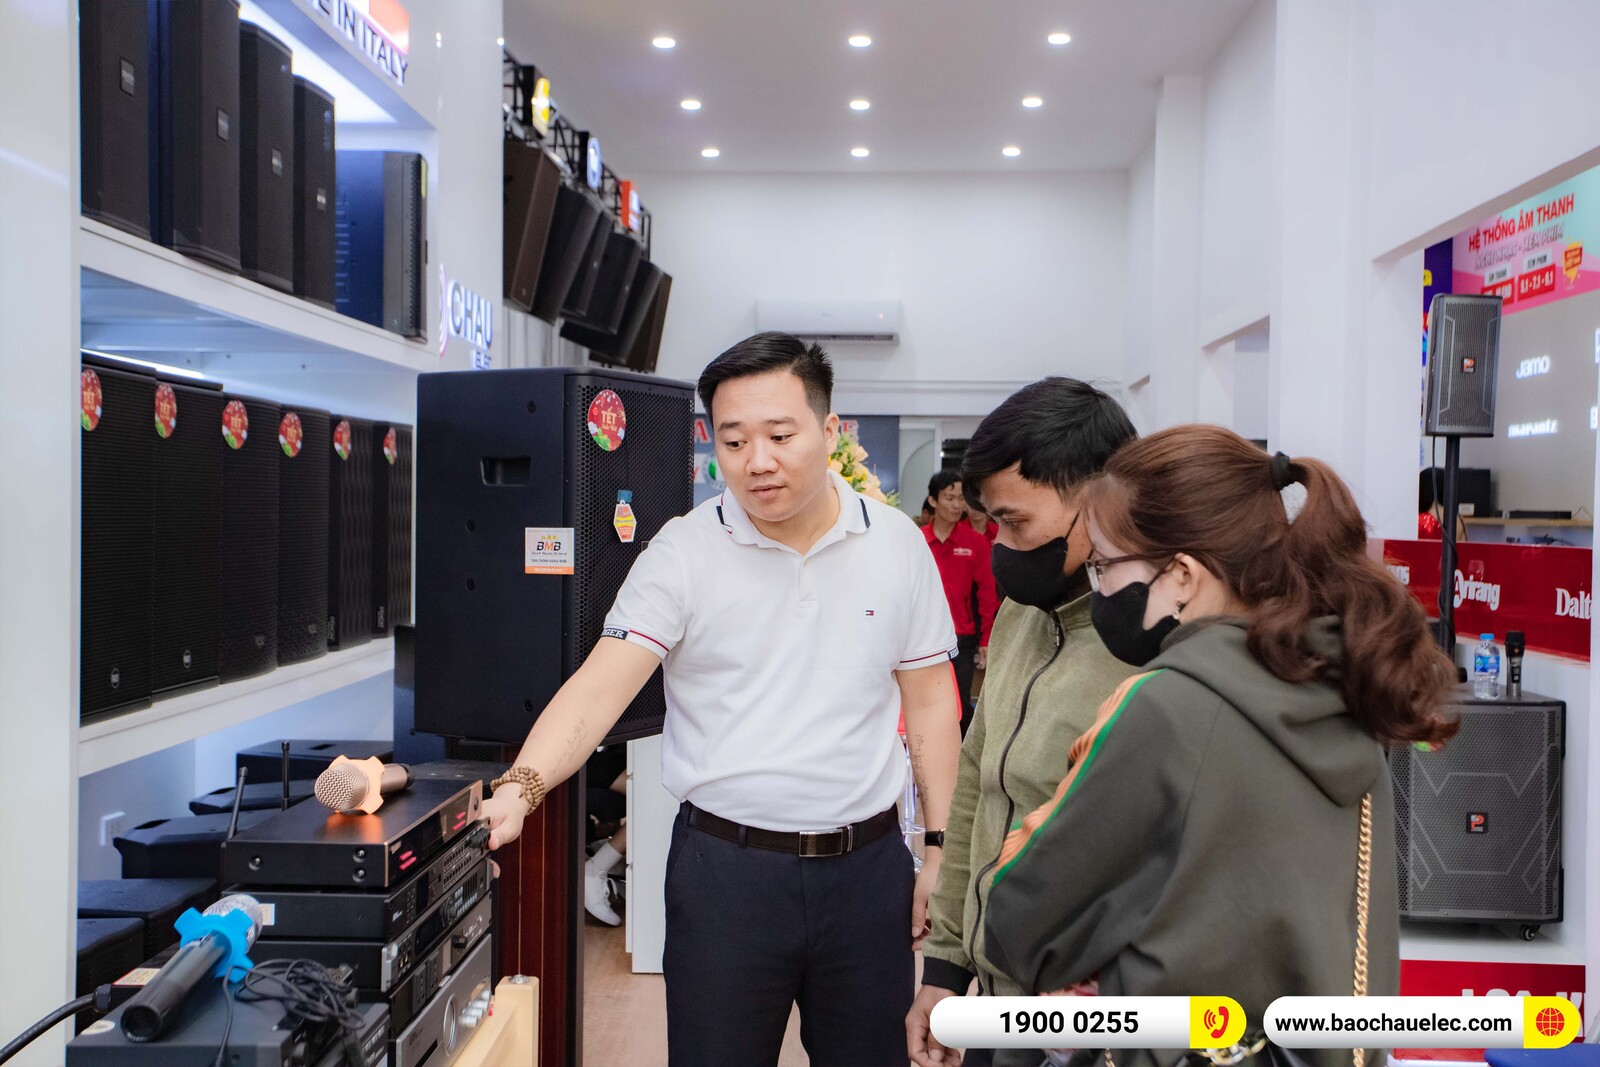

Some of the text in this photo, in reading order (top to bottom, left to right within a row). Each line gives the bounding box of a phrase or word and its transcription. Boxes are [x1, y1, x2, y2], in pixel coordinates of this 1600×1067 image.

[359, 17, 408, 87] ITALY
[1468, 228, 1480, 254] HỆ
[1483, 216, 1515, 246] THỐNG
[1537, 193, 1574, 224] THANH
[601, 406, 617, 425] TẾT
[537, 541, 561, 551] BMB
